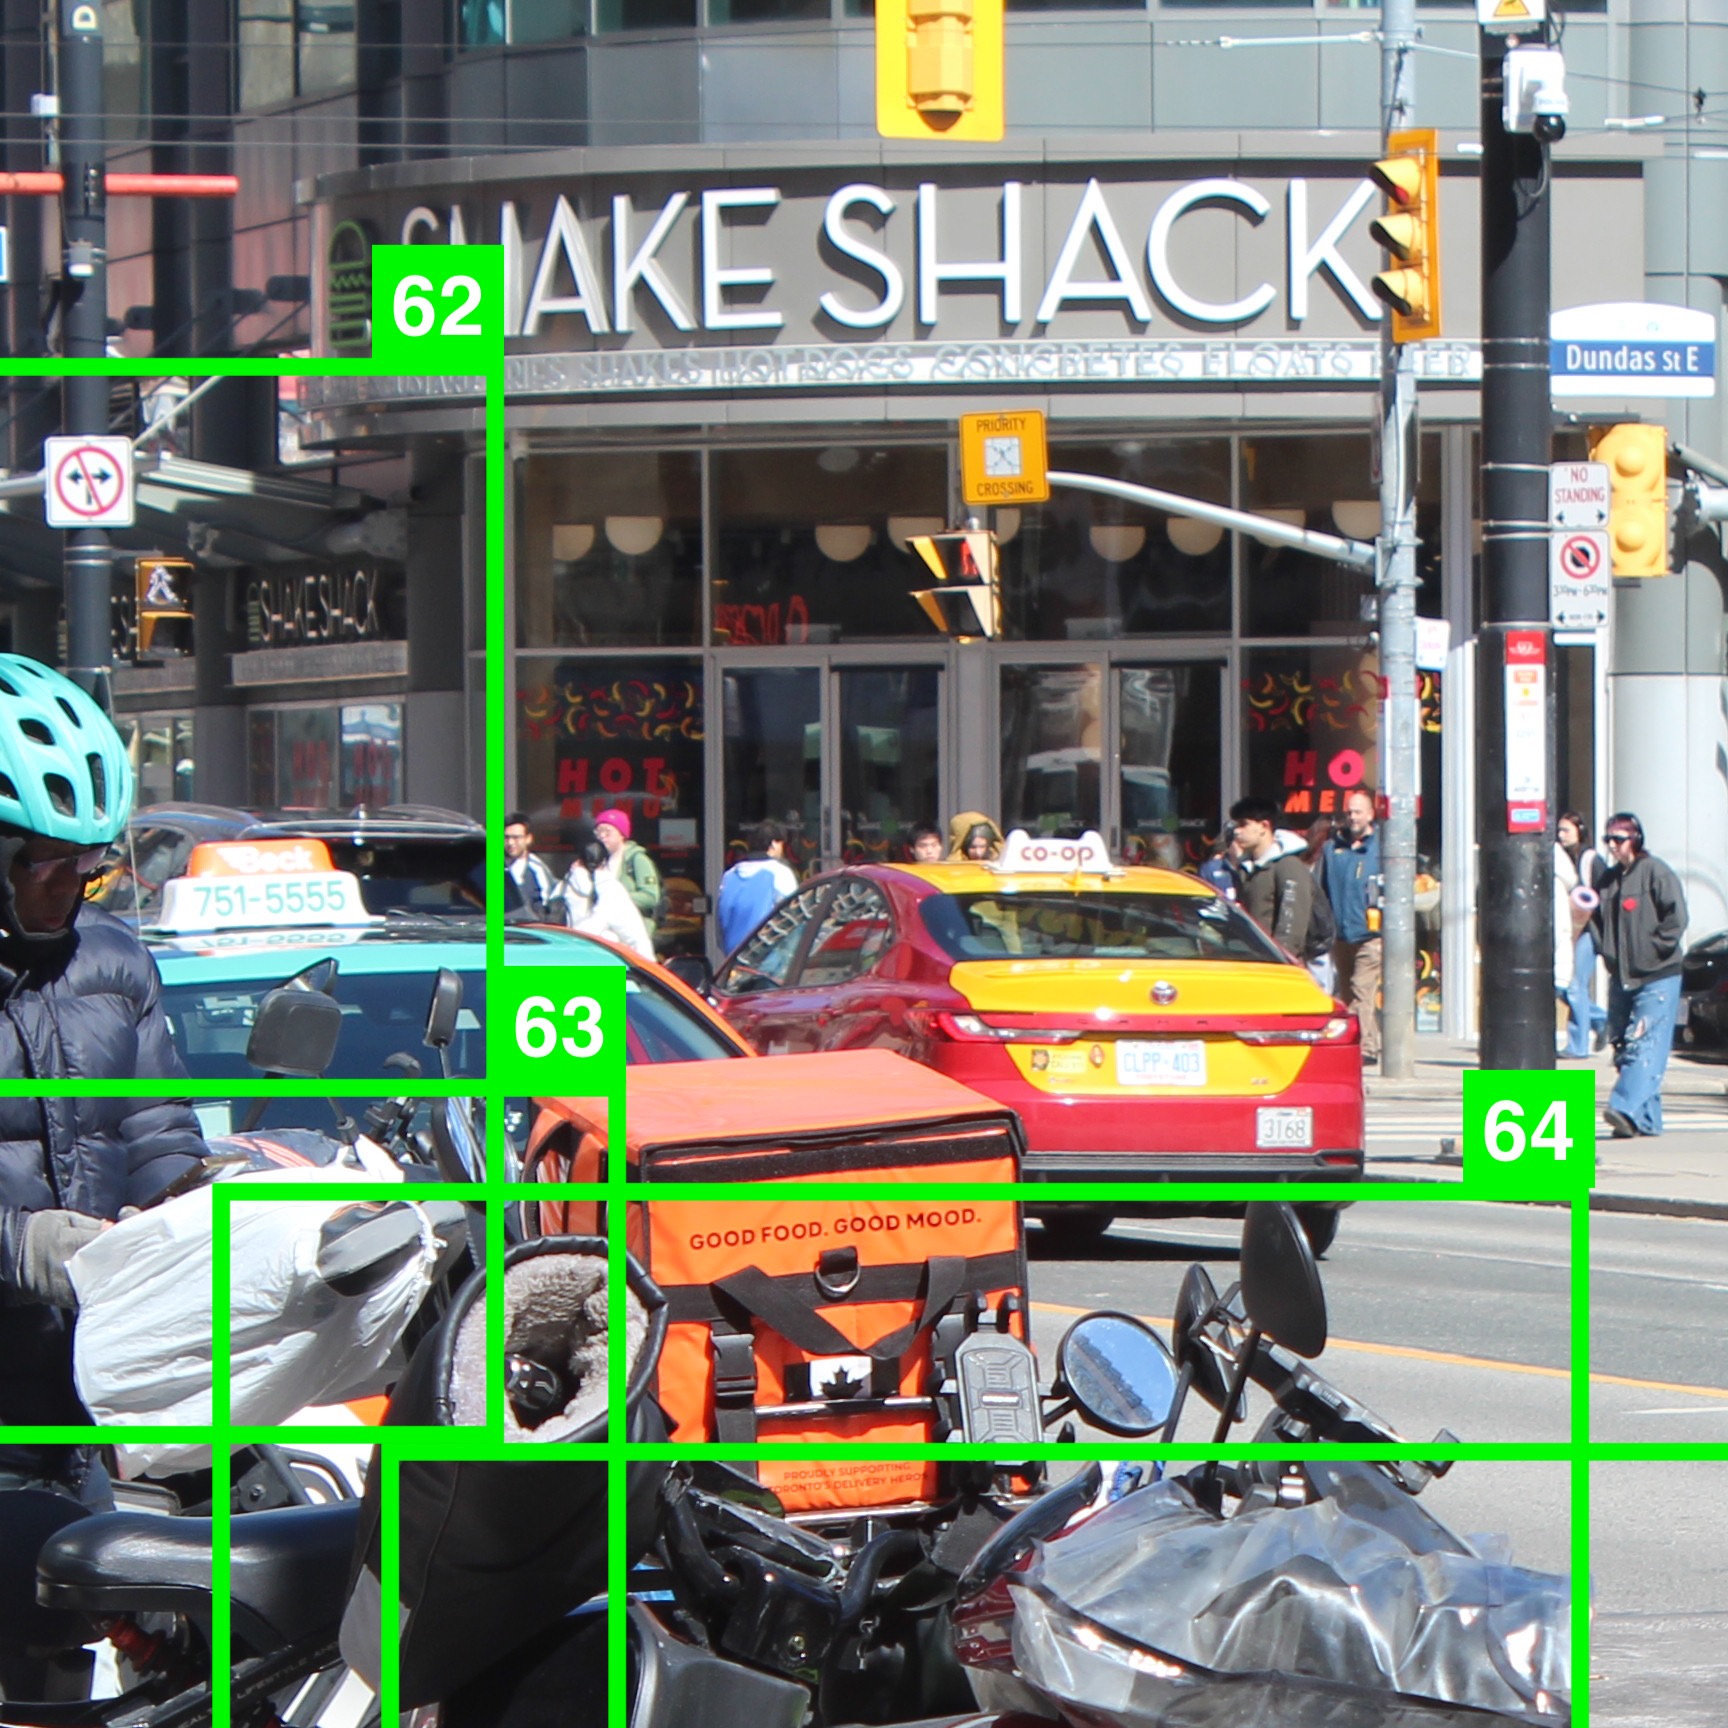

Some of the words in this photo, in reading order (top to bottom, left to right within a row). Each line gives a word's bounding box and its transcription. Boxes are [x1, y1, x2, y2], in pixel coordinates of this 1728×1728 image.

[818, 176, 1385, 329] SHACK
[1566, 344, 1656, 371] Dundas
[1662, 350, 1681, 371] St
[1686, 346, 1699, 372] E
[976, 417, 1026, 432] PRIORITY
[1570, 467, 1588, 483] NO
[976, 480, 1034, 497] CROSSING
[1554, 487, 1606, 504] STANDING
[557, 757, 669, 797] HOT
[220, 846, 314, 873] Beck
[1021, 846, 1095, 867] co-op
[193, 880, 346, 917] 751-5555
[1263, 1116, 1306, 1142] 3168
[690, 1229, 755, 1250] GOOD
[761, 1222, 829, 1243] FOOD.
[833, 1214, 900, 1235] GOOD
[906, 1208, 982, 1230] MOOD.
[783, 1467, 836, 1481] PROUDLY
[838, 1462, 911, 1477] SUPPORTING
[832, 1476, 888, 1491] DELIVERY
